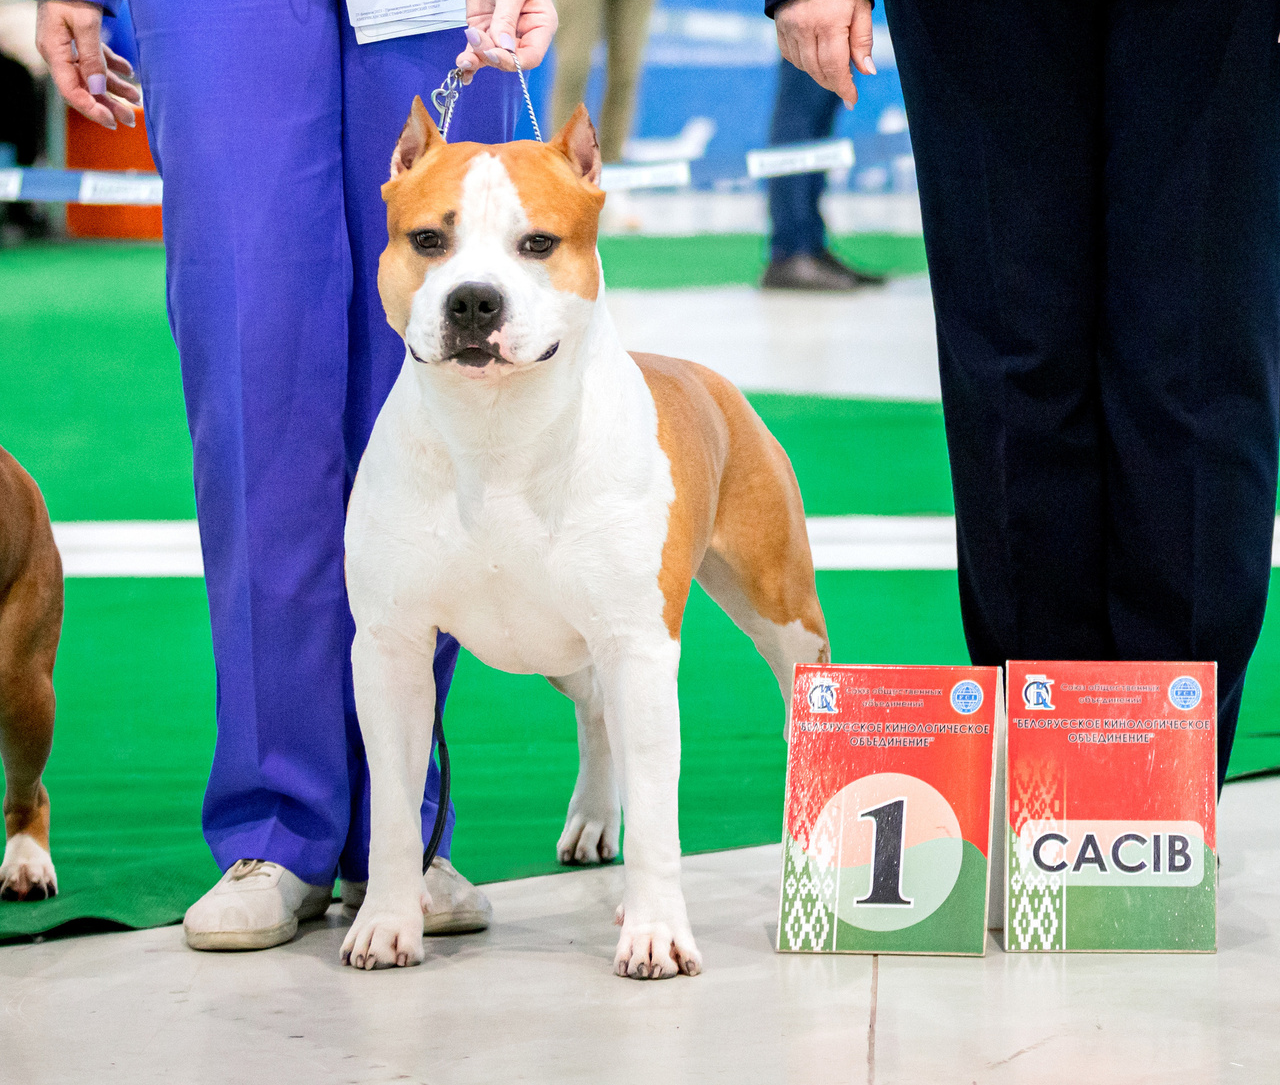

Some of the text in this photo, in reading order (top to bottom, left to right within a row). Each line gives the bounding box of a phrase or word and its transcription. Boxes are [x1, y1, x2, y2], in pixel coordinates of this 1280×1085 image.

[1060, 683, 1160, 693] Союз общественных
[1078, 695, 1142, 704] объединений
[885, 722, 990, 735] КИНОЛОГИЧЕСКОЕ
[1013, 718, 1210, 731] "БЕЛОРУССКОЕ КИНОЛОГИЧЕСКОЕ
[850, 737, 935, 748] ОБЪЕДИНЕНИЕ"
[1067, 733, 1154, 745] ОБЪЕДИНЕНИЕ"
[855, 799, 912, 906] 1
[1032, 833, 1192, 874] CACIB
